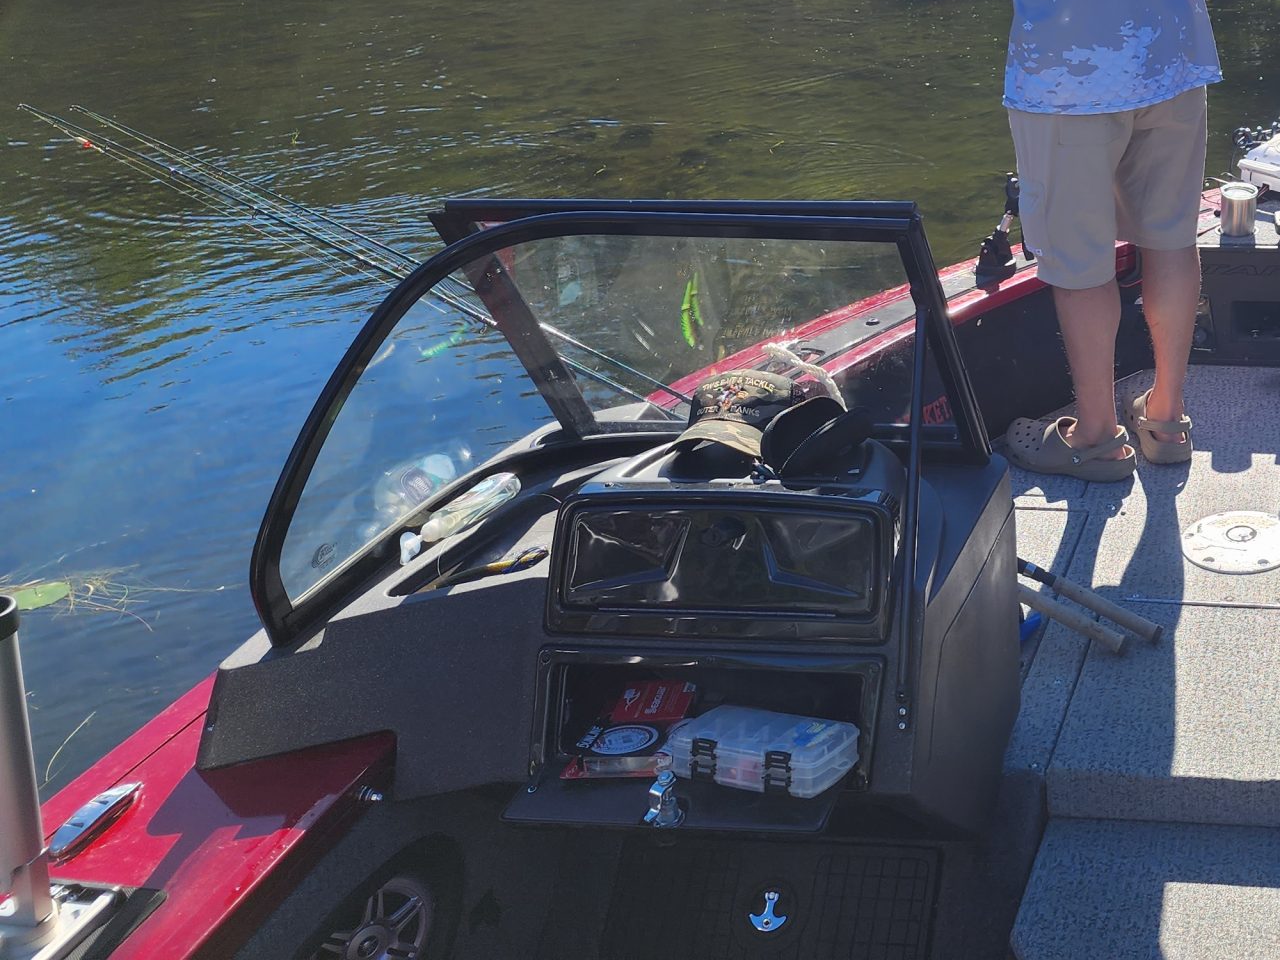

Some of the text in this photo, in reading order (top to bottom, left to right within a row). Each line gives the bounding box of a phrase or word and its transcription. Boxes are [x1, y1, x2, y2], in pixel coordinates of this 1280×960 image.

[745, 377, 775, 393] TACKLE
[696, 405, 760, 417] OUTER BANKS
